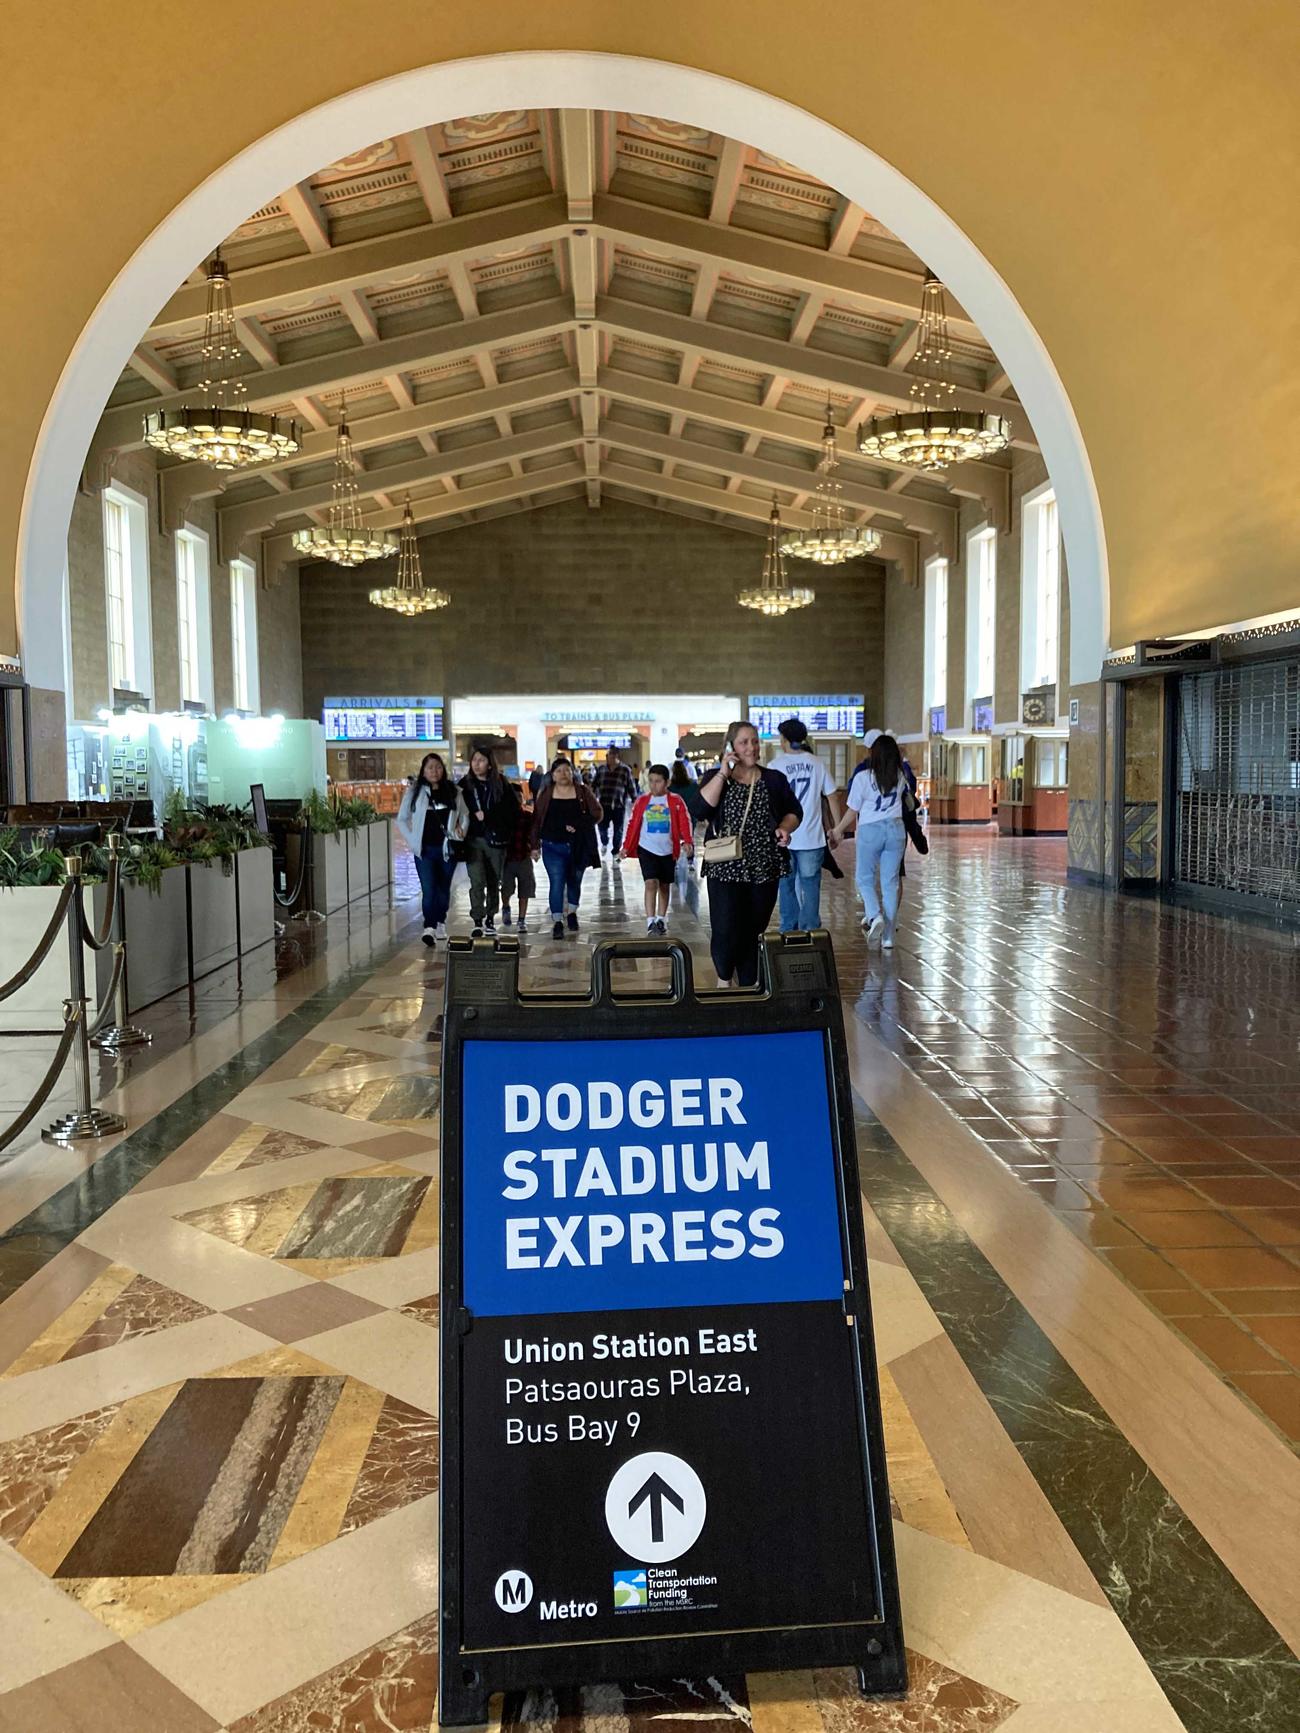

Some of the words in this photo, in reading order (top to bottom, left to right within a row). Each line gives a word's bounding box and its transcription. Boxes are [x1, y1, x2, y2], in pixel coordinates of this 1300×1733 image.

[341, 698, 410, 708] ARRIVALS
[752, 696, 844, 706] DEPARTURES
[545, 712, 558, 720] TO
[560, 712, 592, 720] TRAINS
[603, 712, 620, 720] BUS
[623, 712, 652, 720] PLAZA
[786, 762, 814, 775] OHTANI
[874, 792, 897, 812] 17
[504, 1077, 747, 1133] DODGER
[502, 1141, 771, 1200] STADIUM
[506, 1207, 784, 1270] EXPRESS
[504, 1336, 584, 1364] Union
[592, 1331, 690, 1360] Station
[698, 1328, 758, 1354] East
[505, 1377, 661, 1404] Patsaouras
[669, 1368, 750, 1396] Plaza,
[506, 1418, 559, 1445] Bus
[568, 1414, 618, 1447] Bay
[626, 1411, 641, 1438] 9
[647, 1568, 678, 1578] Clean
[648, 1576, 718, 1589] Transportation
[502, 1577, 526, 1606] M
[648, 1588, 688, 1599] Funding
[539, 1599, 598, 1621] Metro
